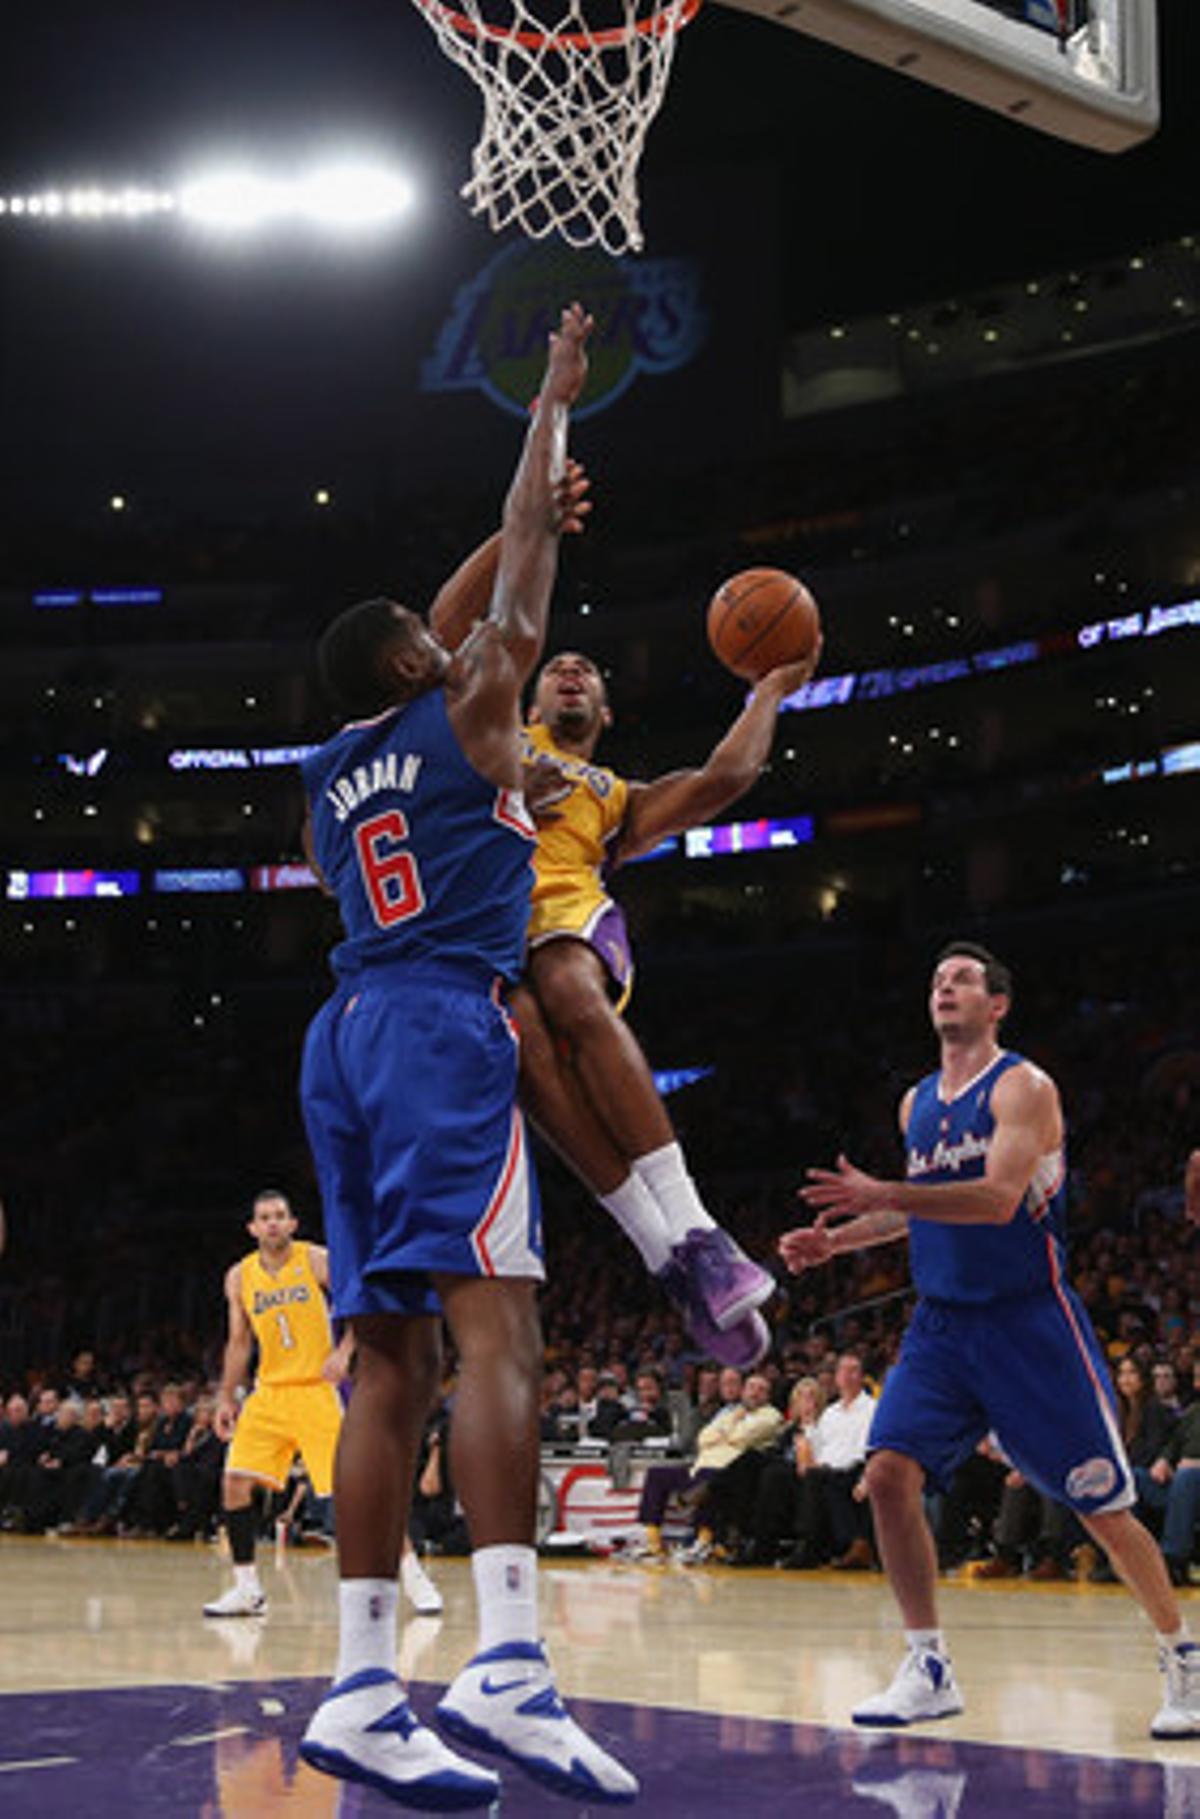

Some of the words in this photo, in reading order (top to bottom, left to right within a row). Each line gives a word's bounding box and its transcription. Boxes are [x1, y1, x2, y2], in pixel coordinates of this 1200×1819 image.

[326, 754, 422, 823] JORDAN
[355, 809, 425, 928] 6
[277, 1313, 295, 1348] 1
